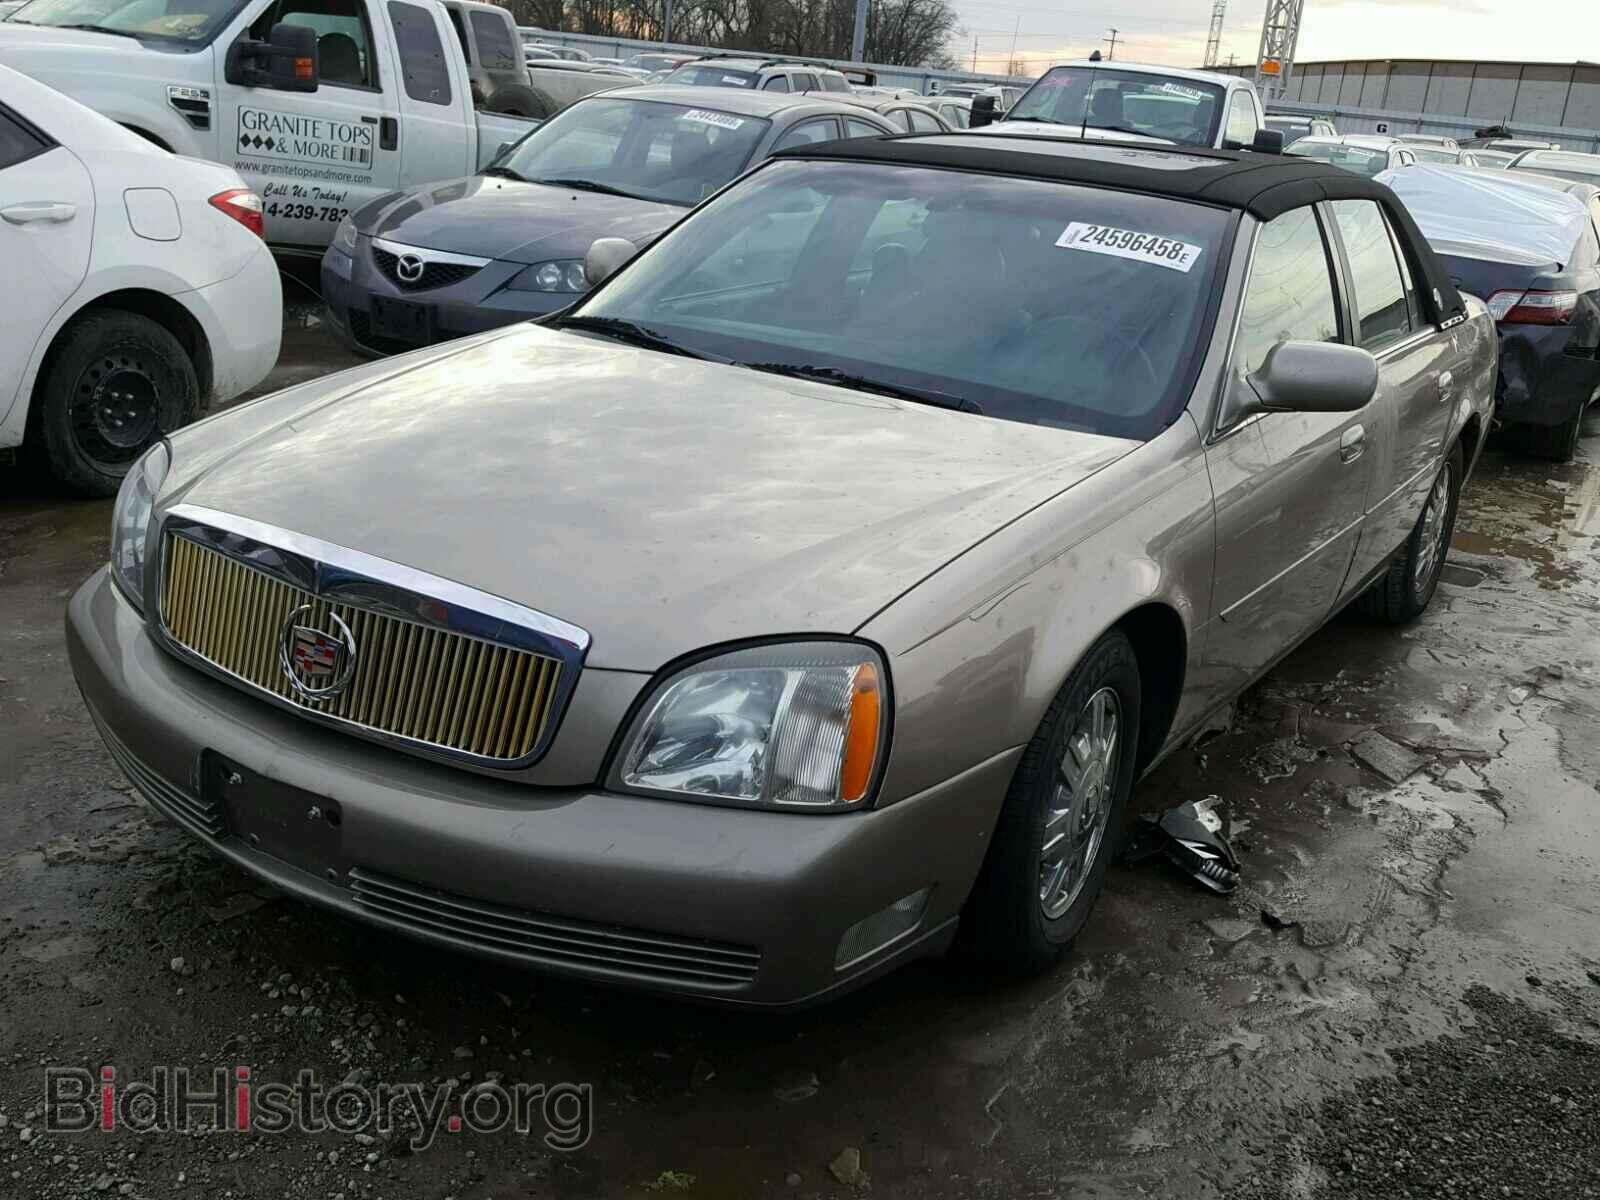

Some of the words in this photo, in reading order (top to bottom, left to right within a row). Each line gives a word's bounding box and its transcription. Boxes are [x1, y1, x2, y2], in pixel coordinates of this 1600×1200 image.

[241, 110, 323, 139] GRANITE
[327, 121, 371, 146] TOPS
[1376, 123, 1388, 134] G
[275, 137, 289, 154] &
[293, 139, 340, 161] MORE
[233, 160, 372, 184] www.granitetopsandmore.com
[263, 182, 288, 198] Call
[292, 185, 308, 198] Us
[311, 187, 348, 204] Today!
